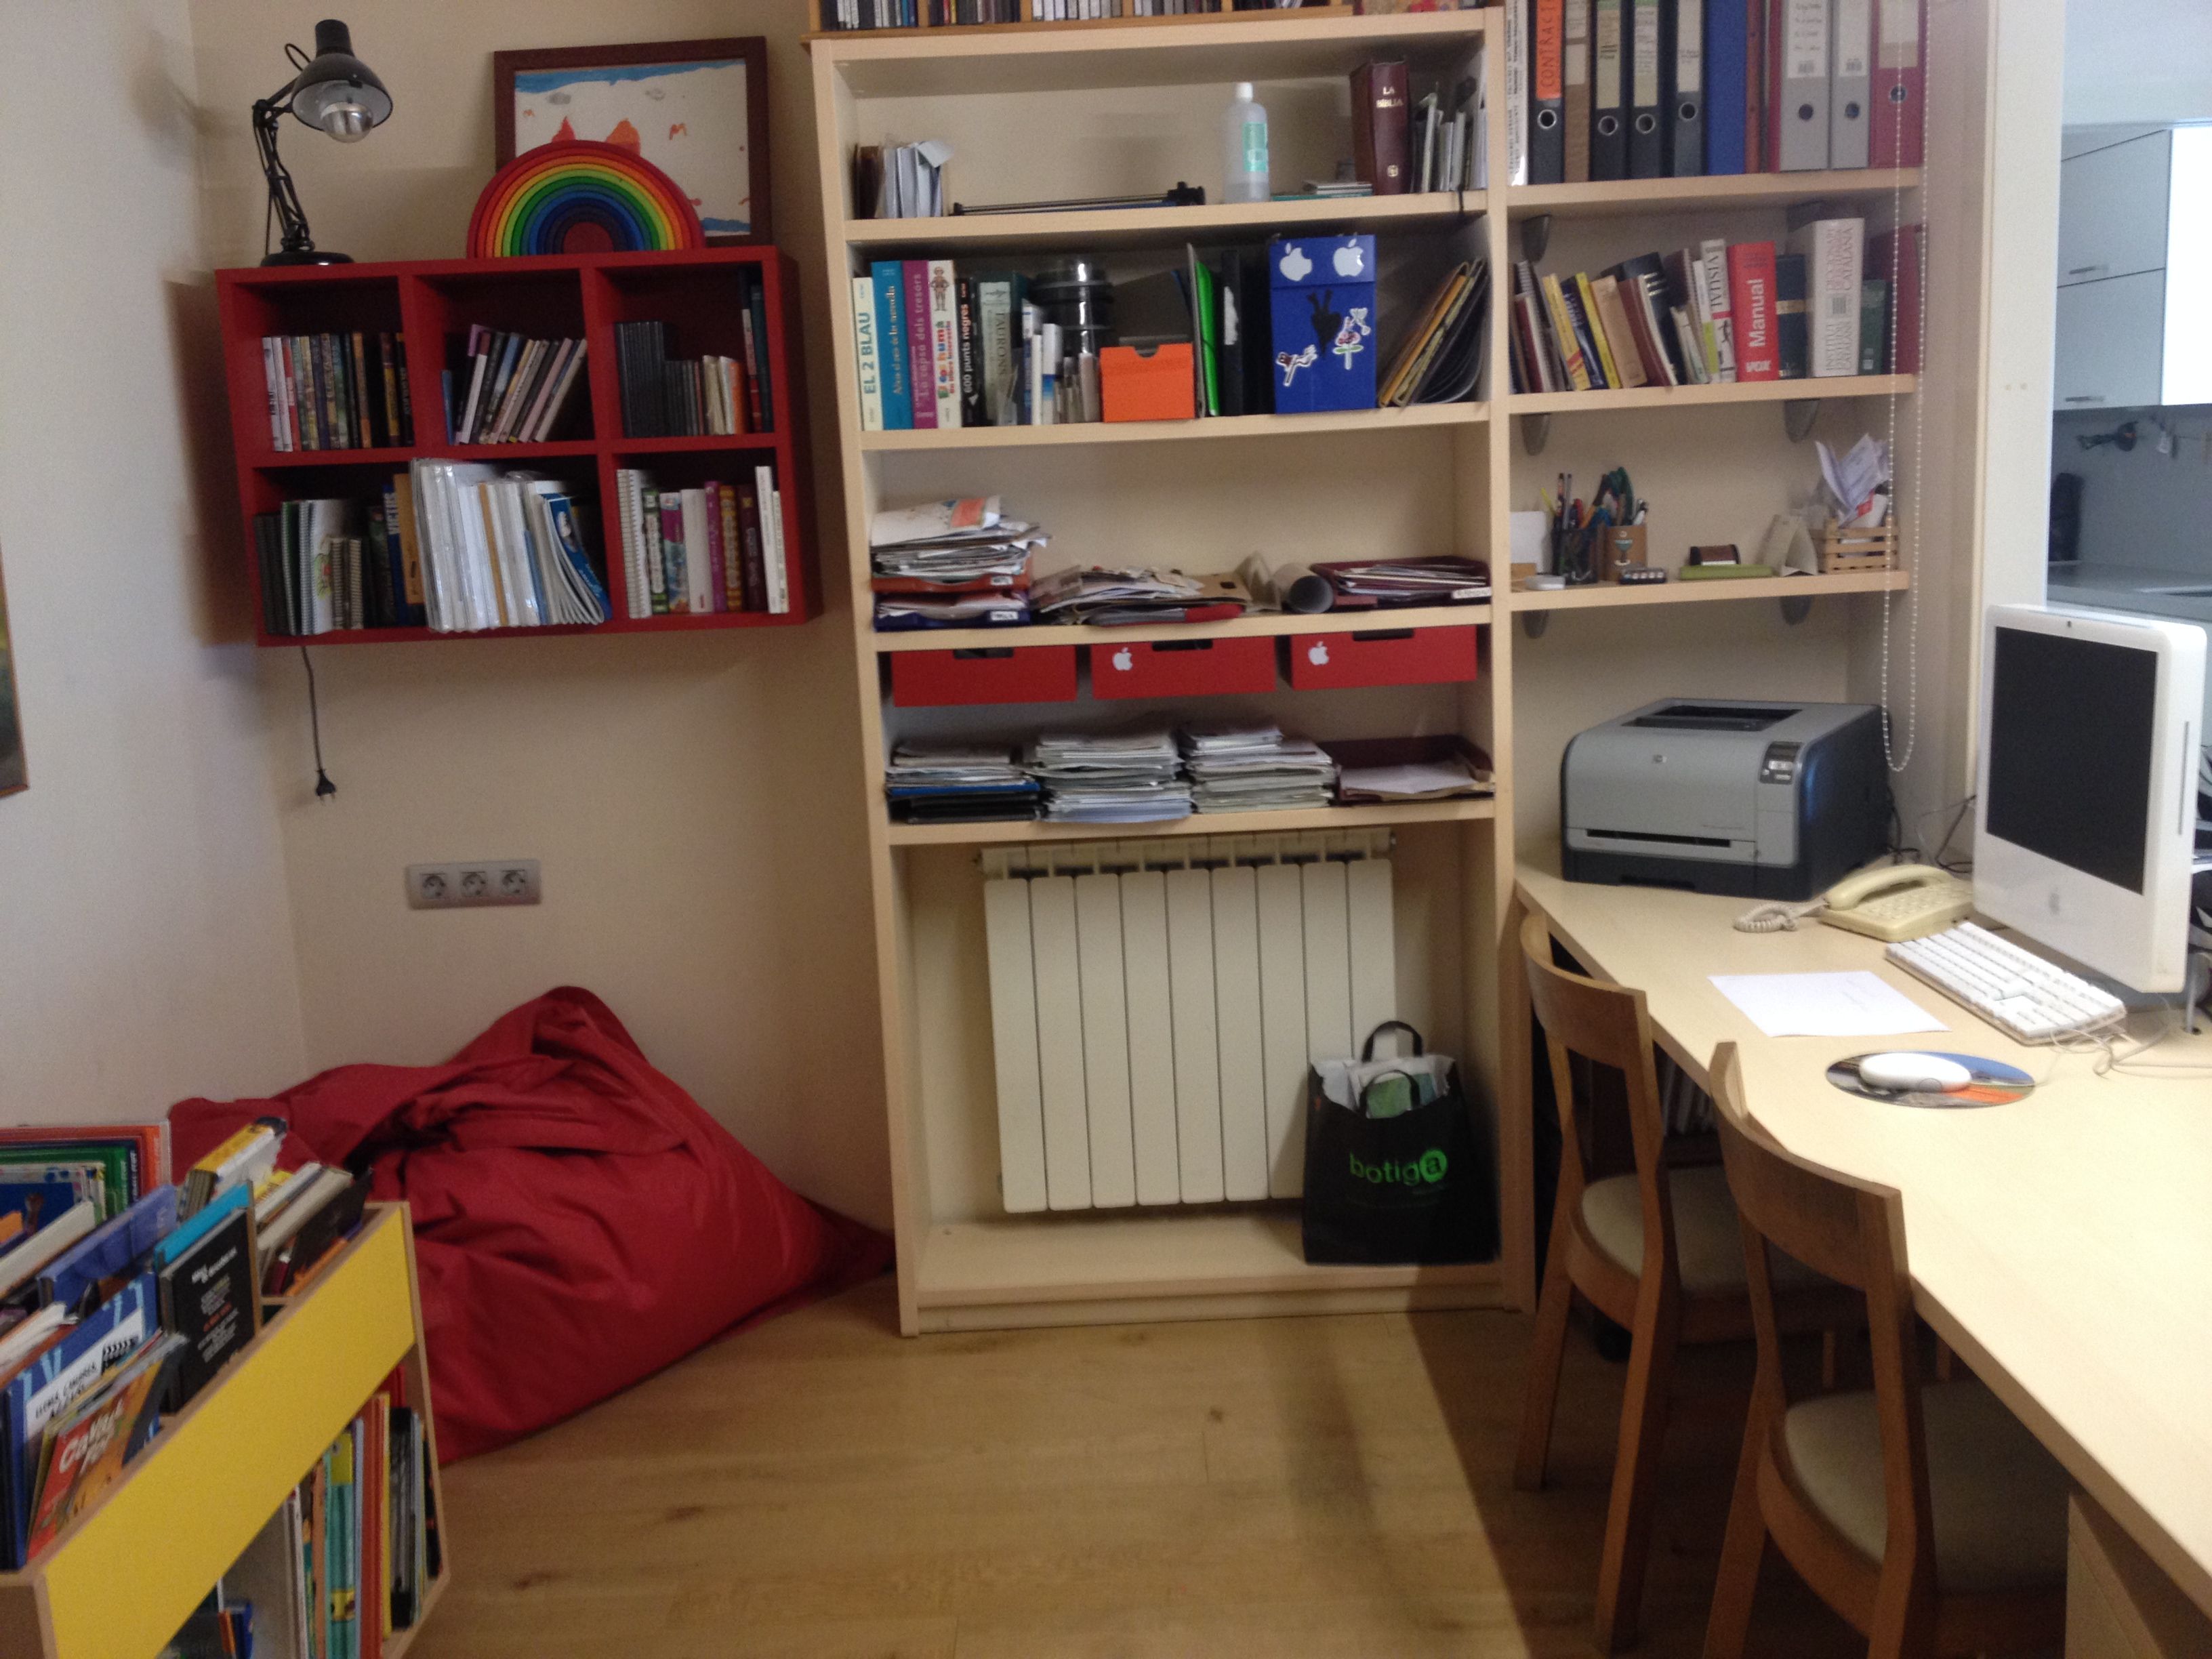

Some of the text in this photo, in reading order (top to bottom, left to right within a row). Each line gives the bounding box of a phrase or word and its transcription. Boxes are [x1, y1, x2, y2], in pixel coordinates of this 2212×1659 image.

[1539, 0, 1555, 87] CONTRACT
[1382, 86, 1395, 94] LA
[913, 273, 924, 313] tresors
[1706, 255, 1723, 309] VISUAL
[858, 312, 873, 356] BLAU
[914, 316, 926, 341] dels
[1747, 279, 1766, 348] Manual
[862, 359, 874, 371] 2
[959, 304, 973, 393] 600 punts negres
[863, 375, 876, 394] EL
